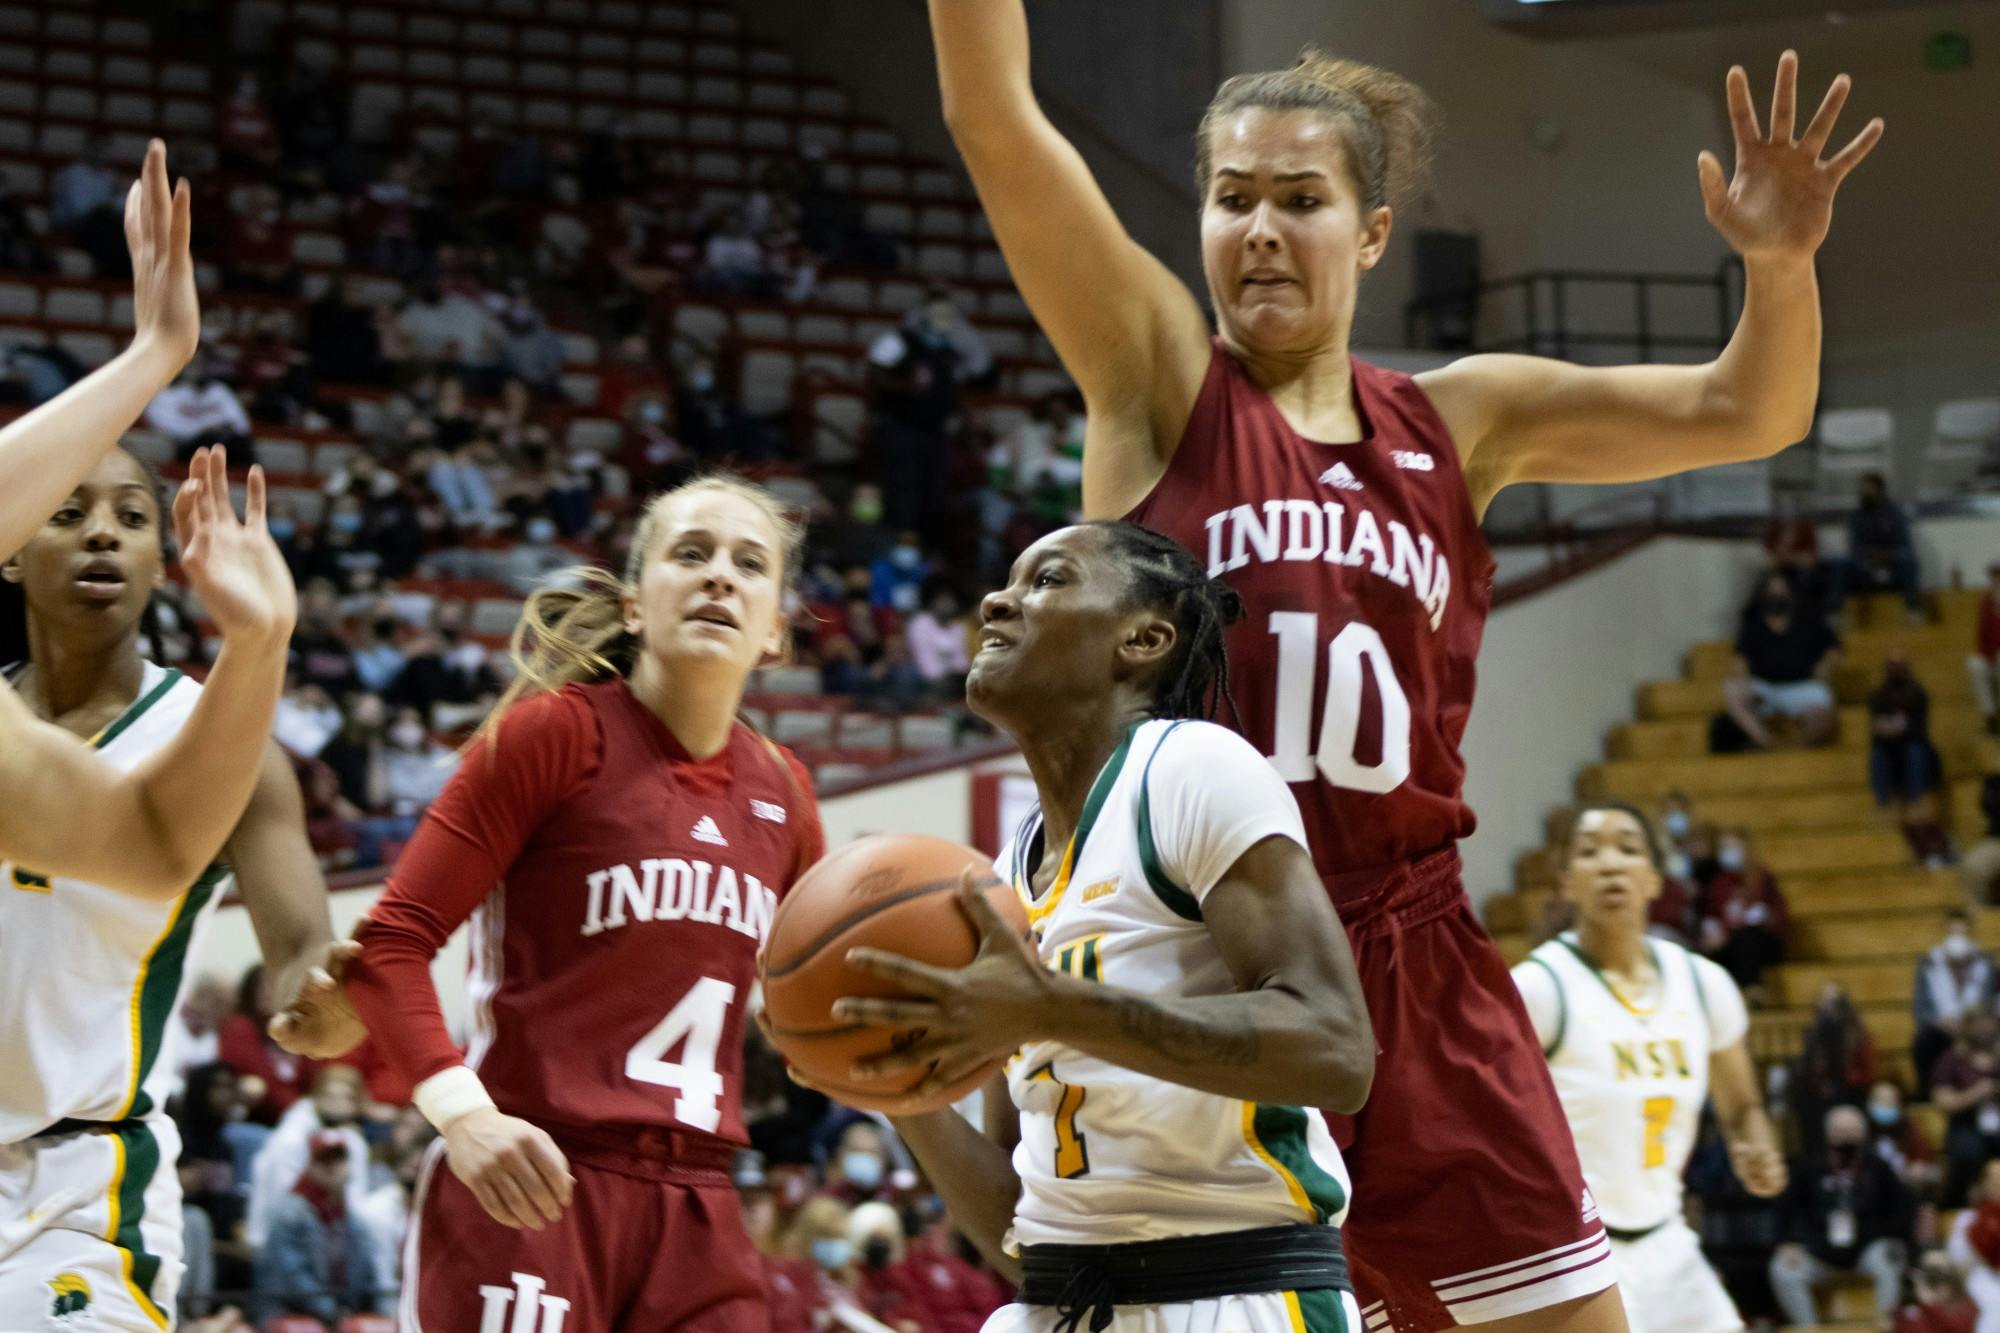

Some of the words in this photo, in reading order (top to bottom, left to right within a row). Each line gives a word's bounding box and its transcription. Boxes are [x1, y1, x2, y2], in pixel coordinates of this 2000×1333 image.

[1204, 499, 1450, 633] INDIANA
[1266, 611, 1411, 795] 10
[581, 858, 778, 951] INDIAN
[625, 976, 736, 1134] 4
